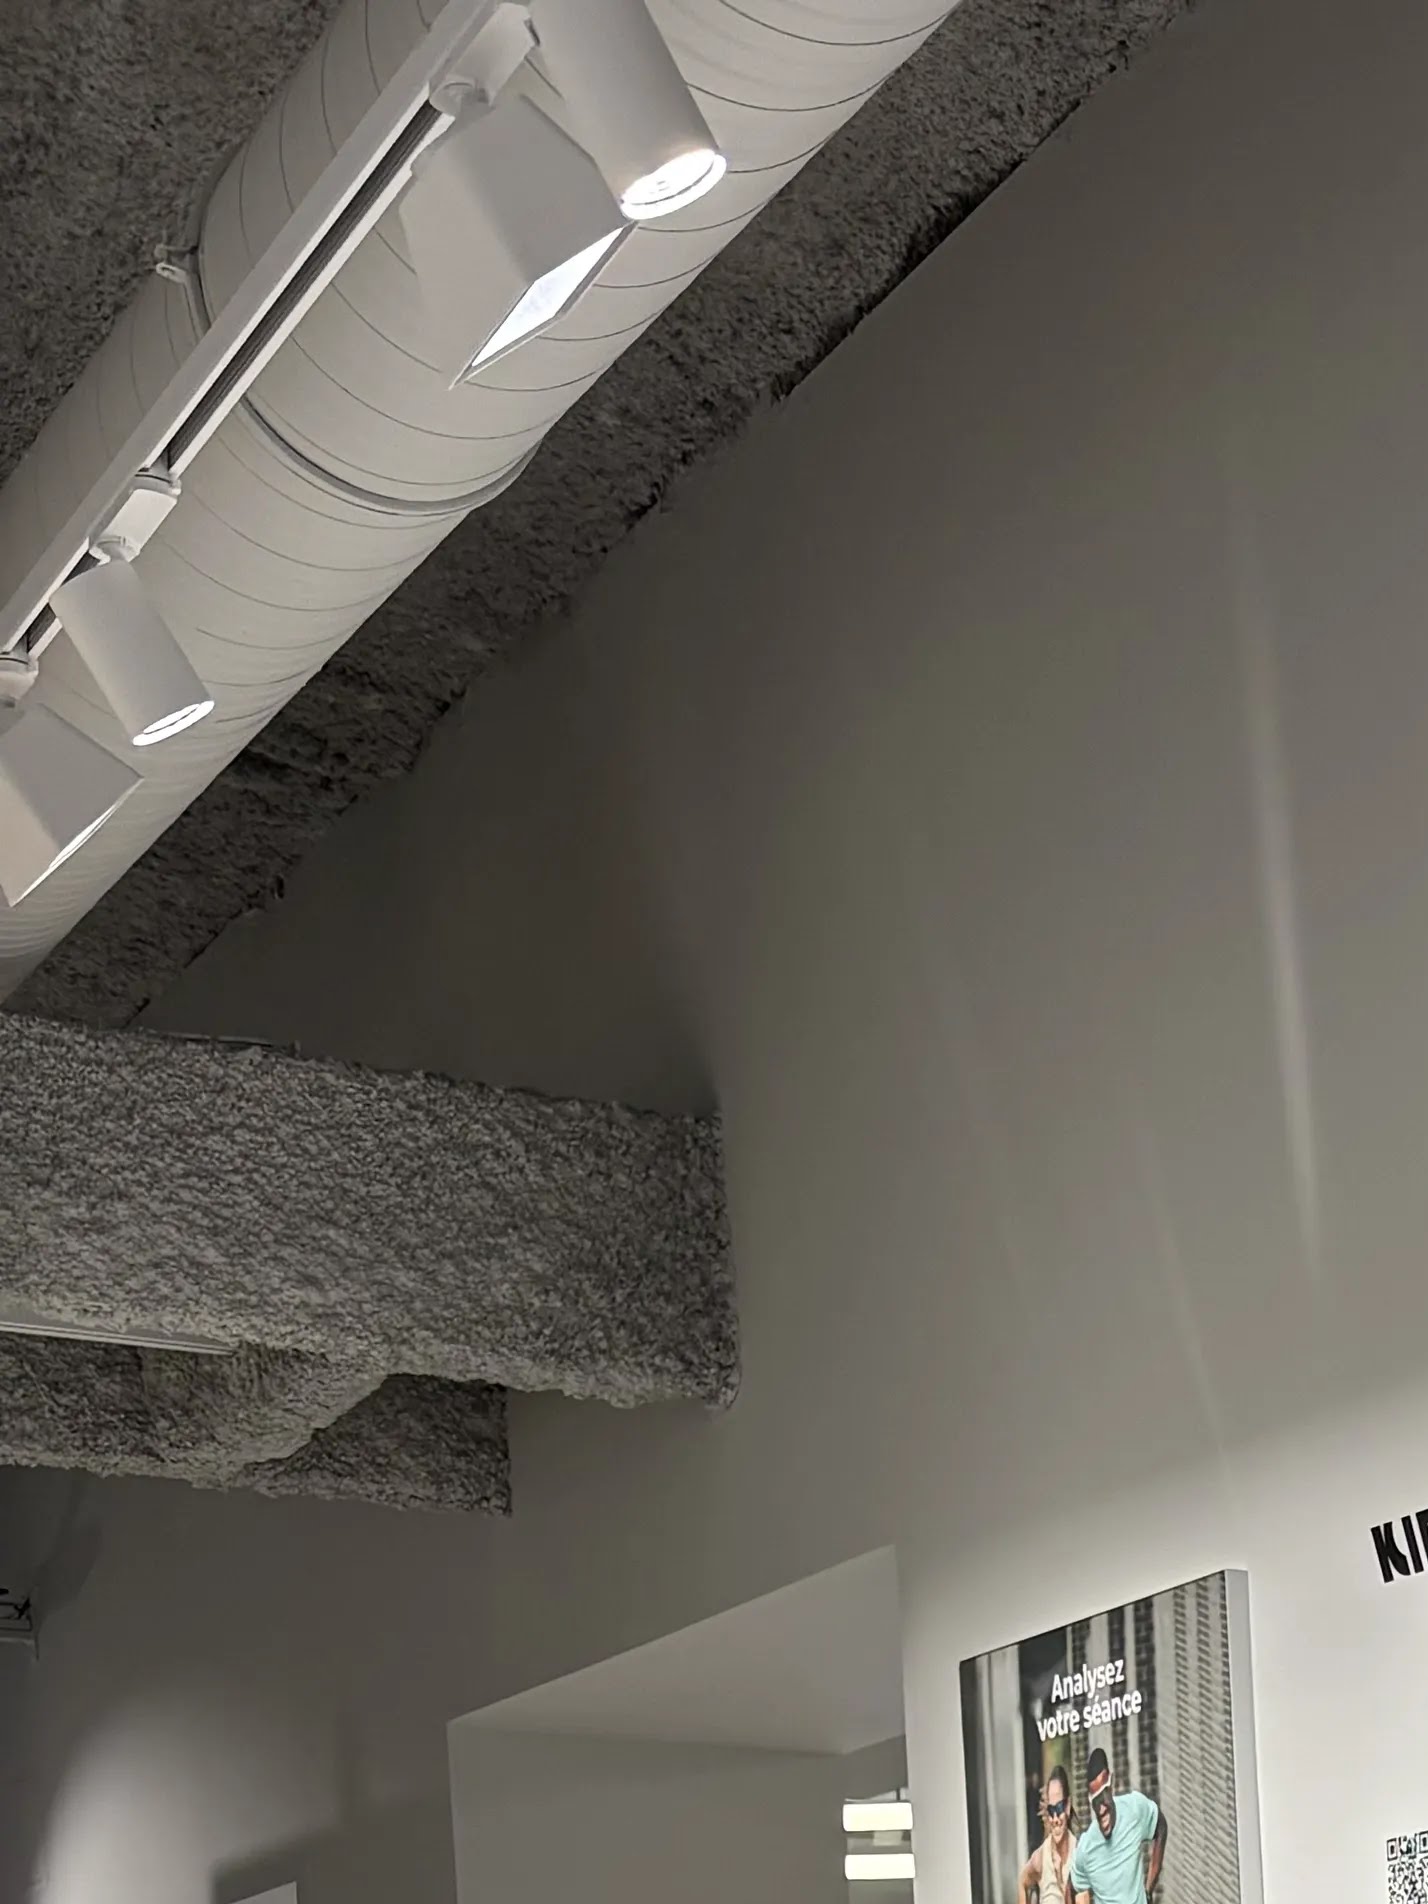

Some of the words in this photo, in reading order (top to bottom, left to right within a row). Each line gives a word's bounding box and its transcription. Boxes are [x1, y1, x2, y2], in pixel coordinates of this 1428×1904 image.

[1051, 1659, 1124, 1703] Analysez
[1037, 1709, 1080, 1742] votre
[1083, 1690, 1142, 1728] séance
